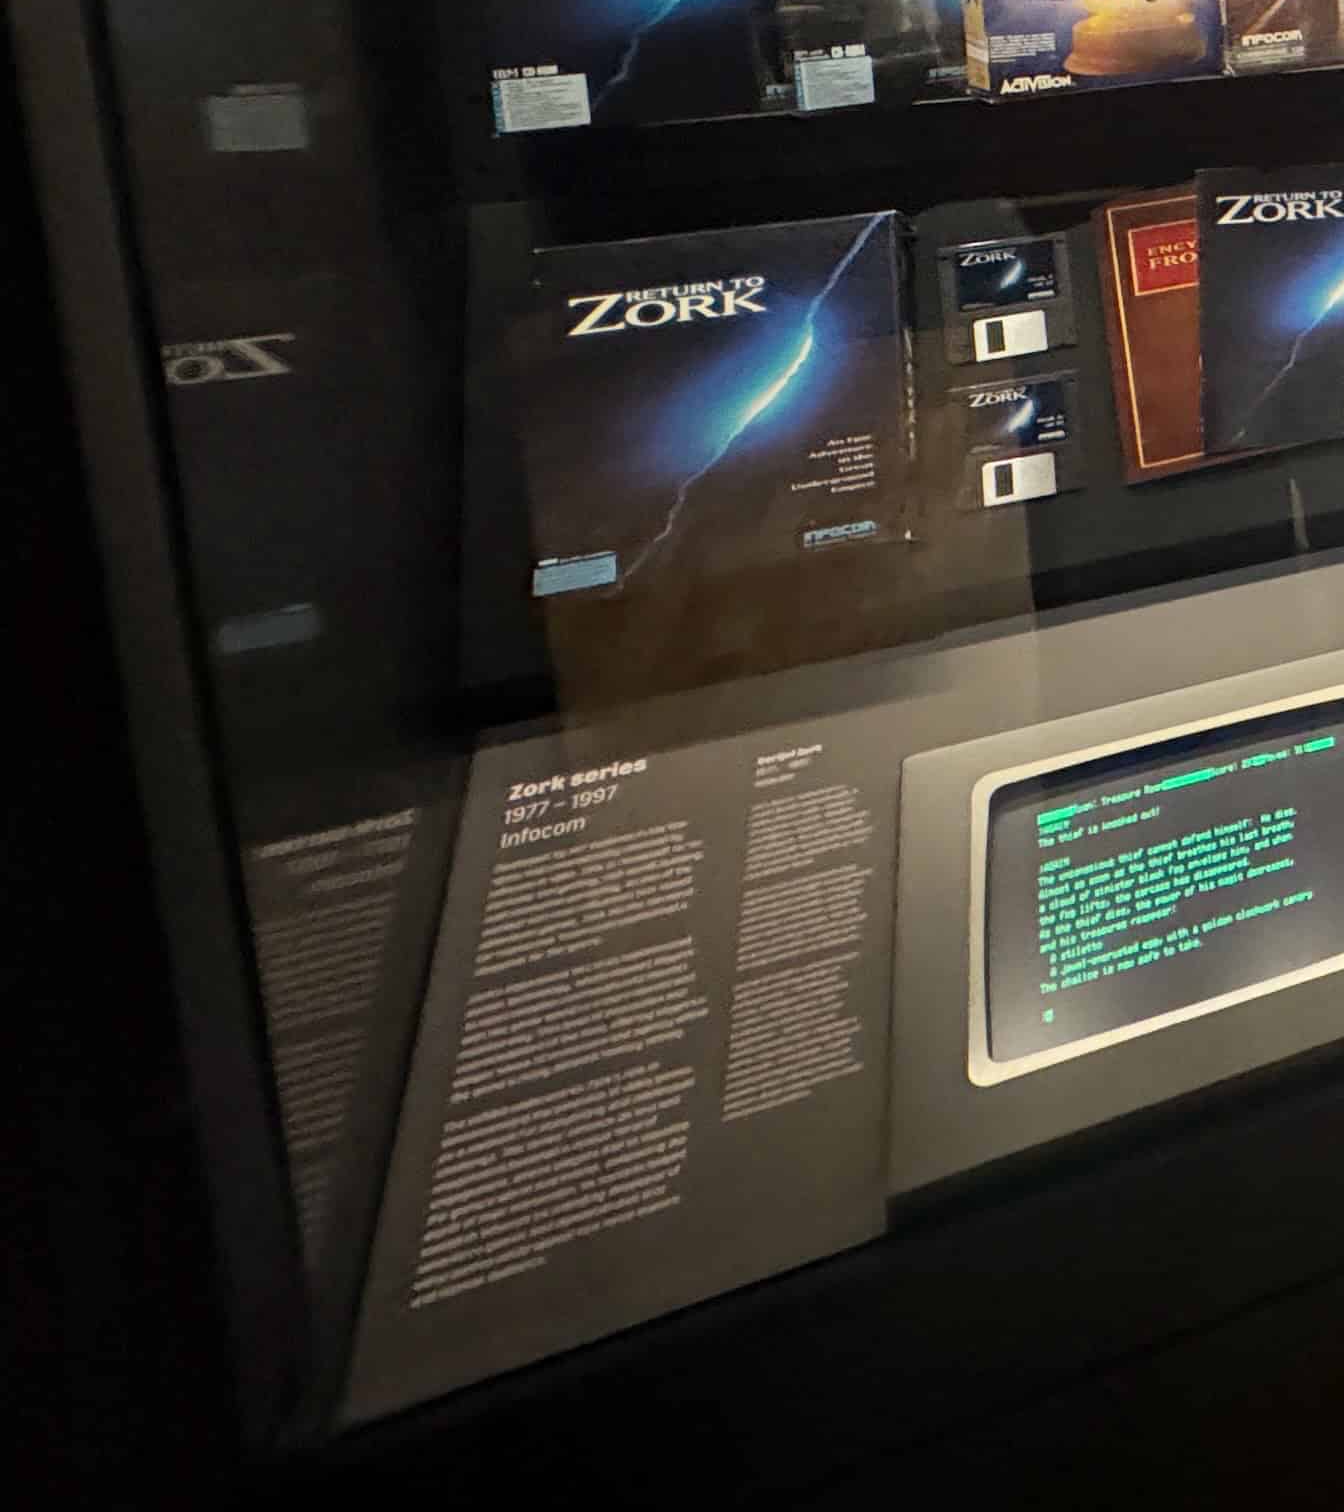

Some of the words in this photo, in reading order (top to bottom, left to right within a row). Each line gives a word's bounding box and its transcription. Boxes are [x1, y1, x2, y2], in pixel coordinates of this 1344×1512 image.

[1000, 76, 1072, 95] ACTIVISION
[1253, 192, 1315, 205] RETURN
[1319, 190, 1342, 201] TO
[1216, 195, 1344, 225] ZORK
[1147, 241, 1197, 256] ENCY
[960, 251, 1016, 267] ZORK
[1150, 252, 1198, 270] FRO
[625, 280, 723, 304] RETURN
[729, 276, 765, 289] TO
[567, 288, 767, 338] ZORK
[968, 389, 1028, 408] ZORK
[508, 775, 565, 801] Zork
[569, 757, 648, 788] series
[503, 800, 551, 826] 1977
[569, 785, 620, 812] 1997
[500, 815, 587, 849] Infocom
[1038, 876, 1055, 887] The
